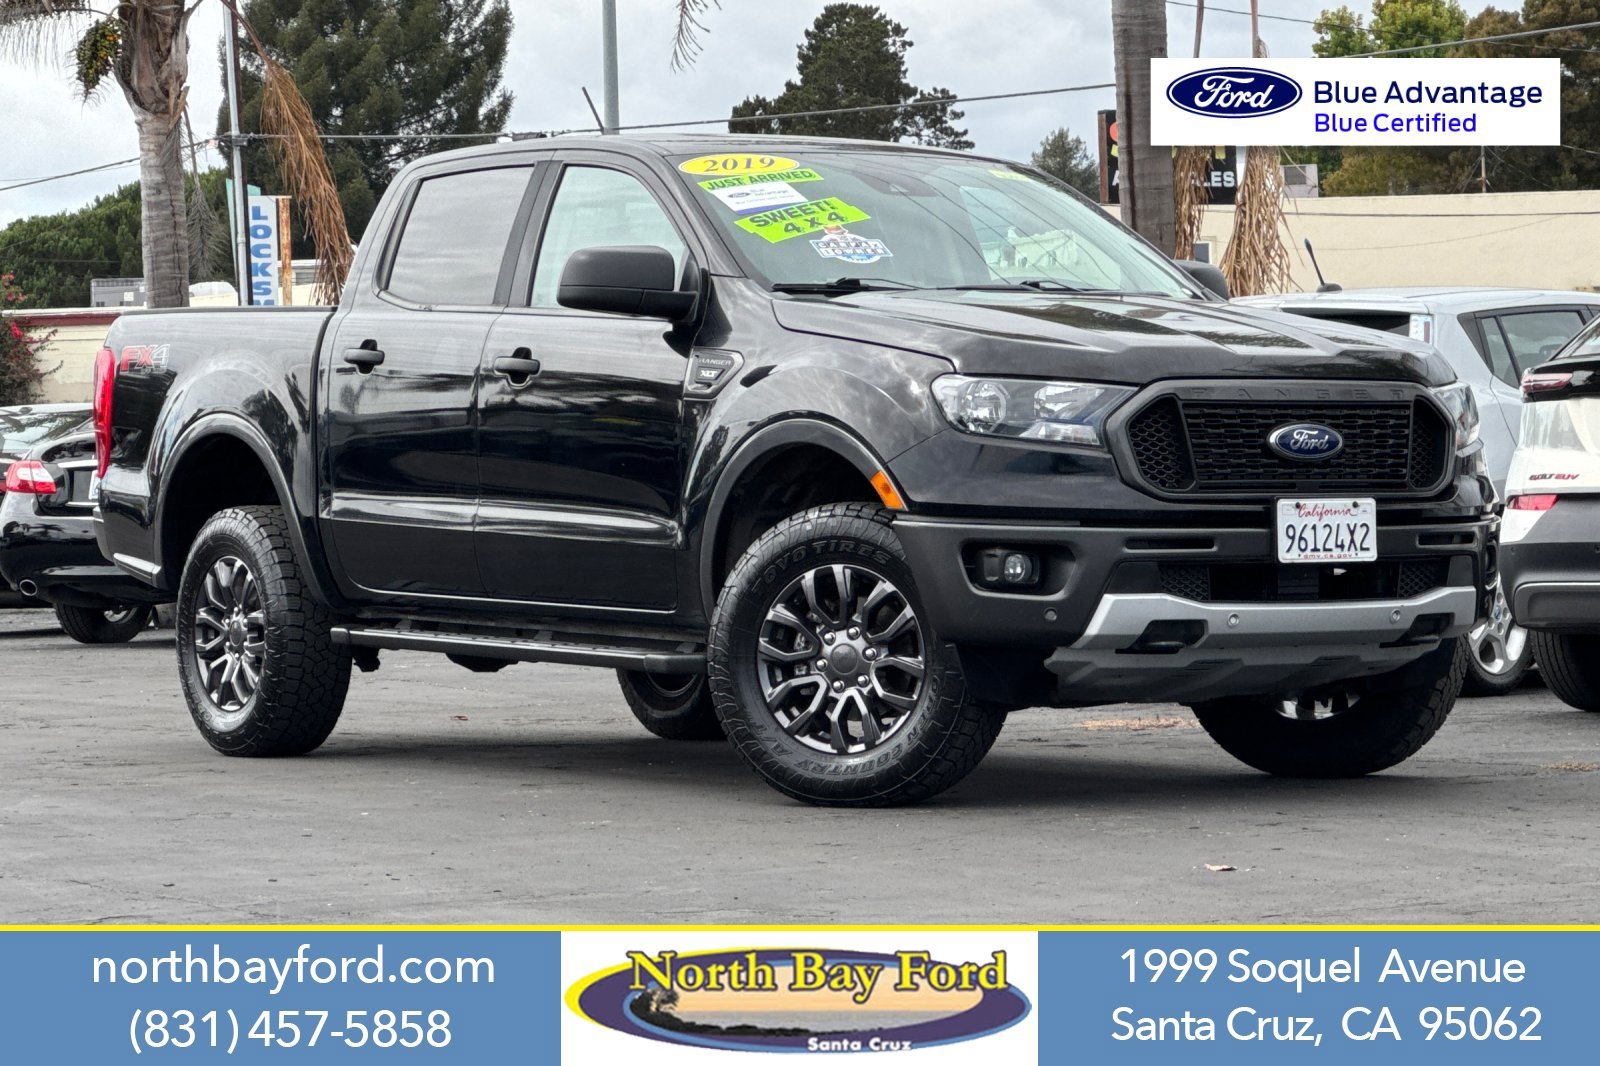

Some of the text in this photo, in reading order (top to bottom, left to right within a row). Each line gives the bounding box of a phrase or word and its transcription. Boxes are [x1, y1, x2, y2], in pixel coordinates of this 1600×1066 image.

[703, 157, 775, 173] 2019
[706, 169, 813, 191] JUST ARRIVED
[749, 200, 836, 227] SWEET!
[783, 222, 803, 235] 4
[827, 211, 847, 224] 4
[120, 344, 170, 373] FX4
[1190, 387, 1406, 400] RANGER
[1289, 429, 1329, 450] Ford
[1298, 504, 1357, 521] California
[1285, 523, 1370, 553] 96124X2
[812, 539, 892, 566] TIRES
